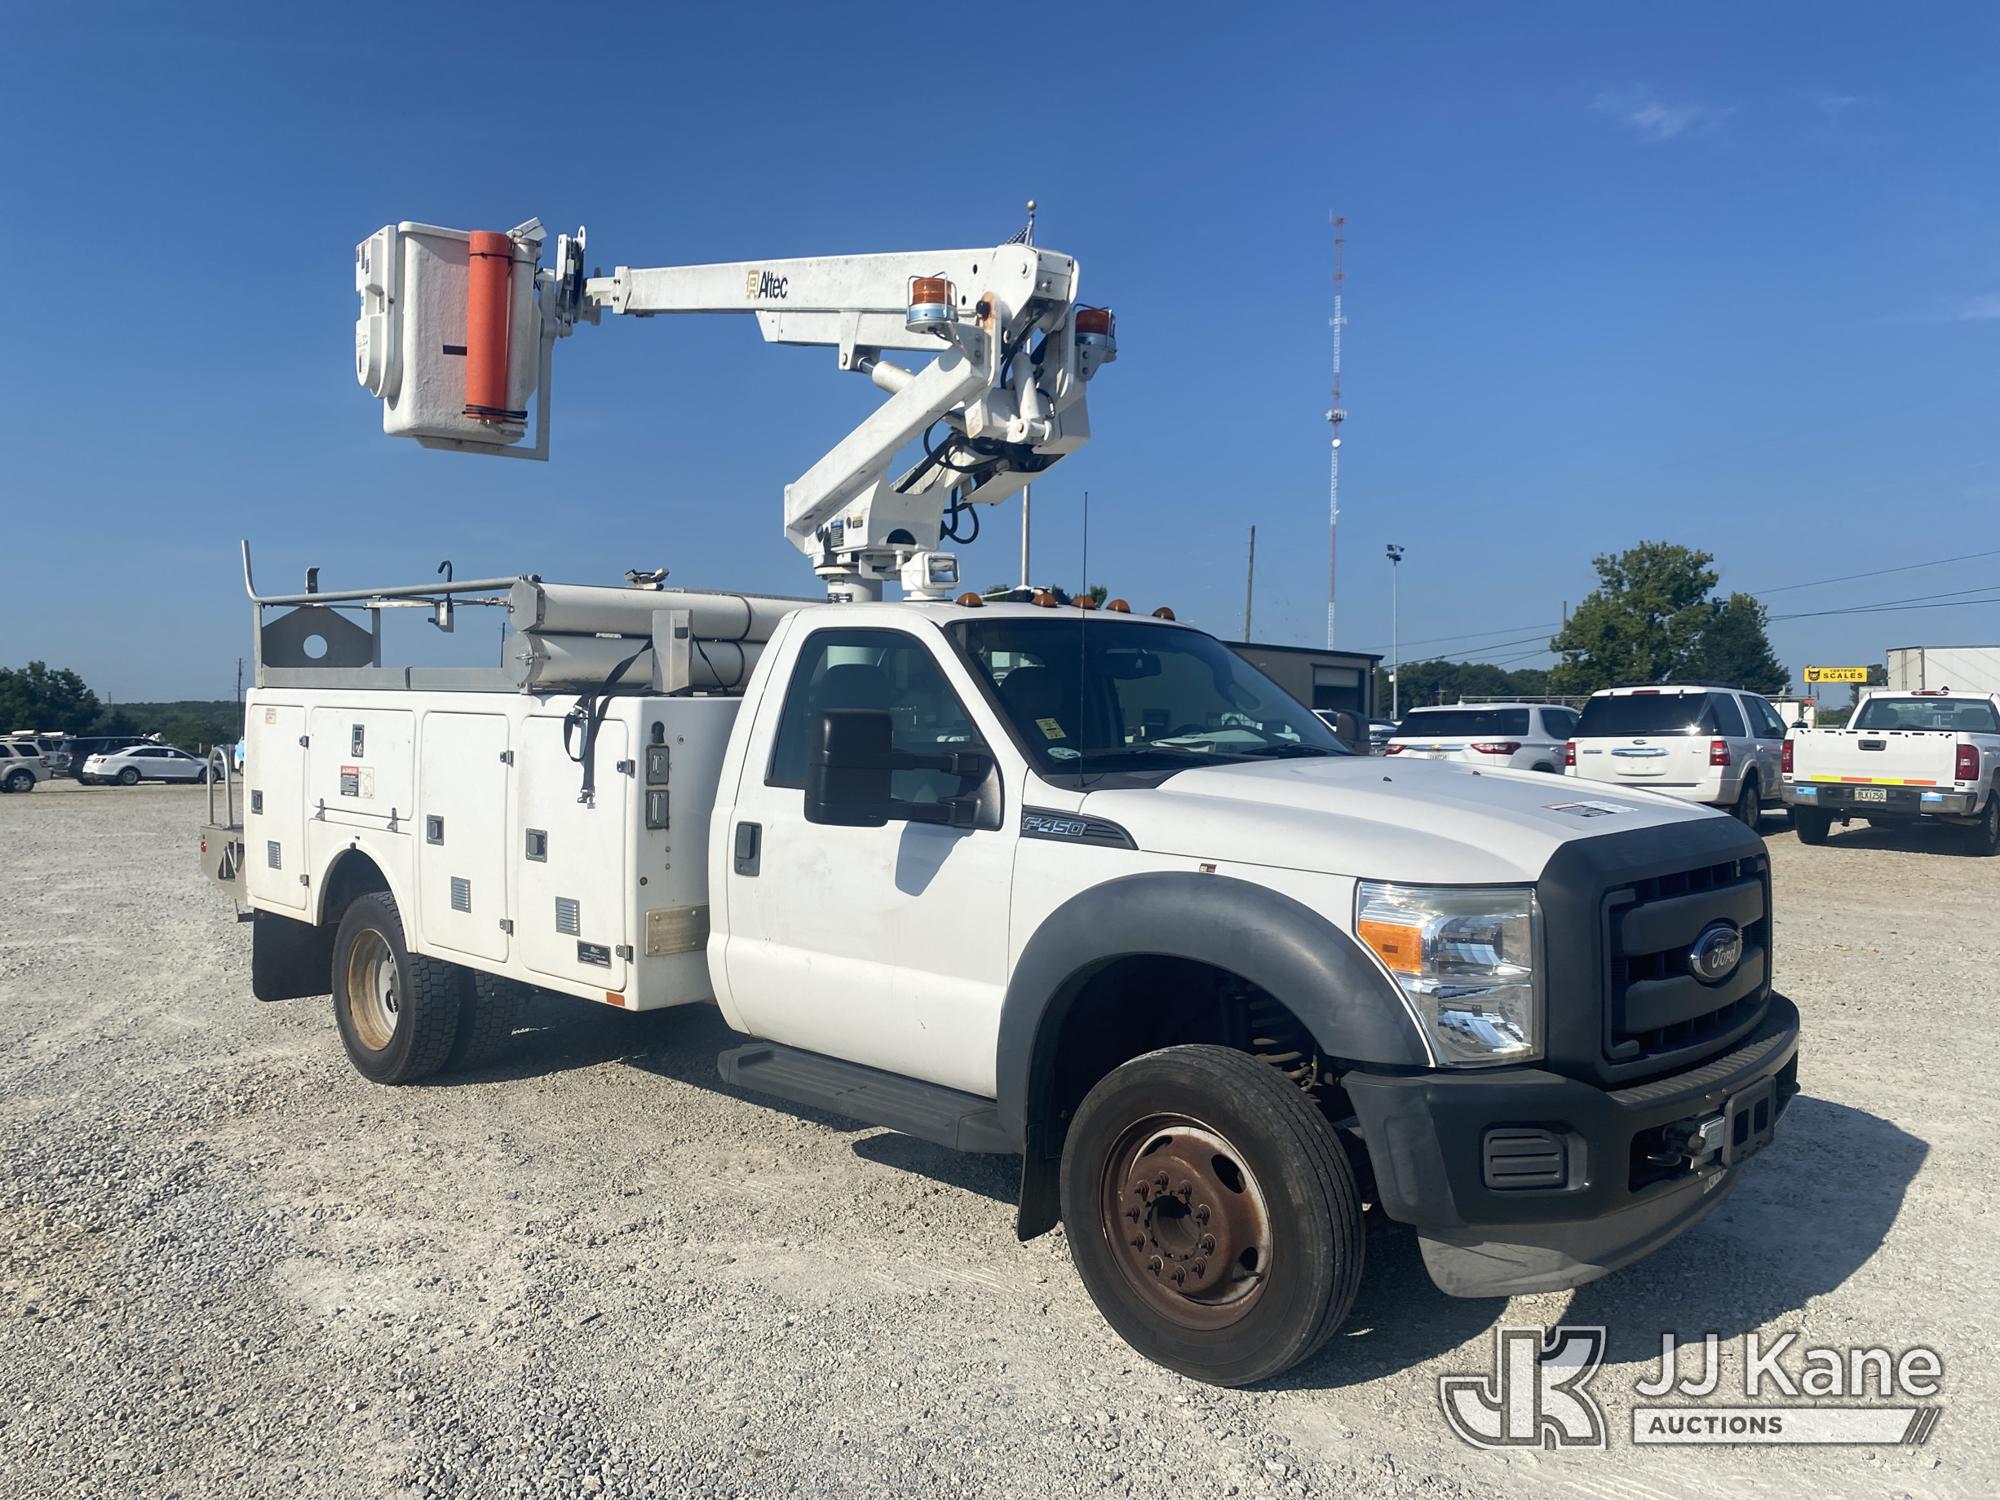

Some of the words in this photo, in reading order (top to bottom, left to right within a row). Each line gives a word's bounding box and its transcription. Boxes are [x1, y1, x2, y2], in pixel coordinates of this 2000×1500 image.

[758, 271, 788, 299] Altec
[1022, 816, 1087, 836] F-450
[1711, 941, 1737, 969] Ford
